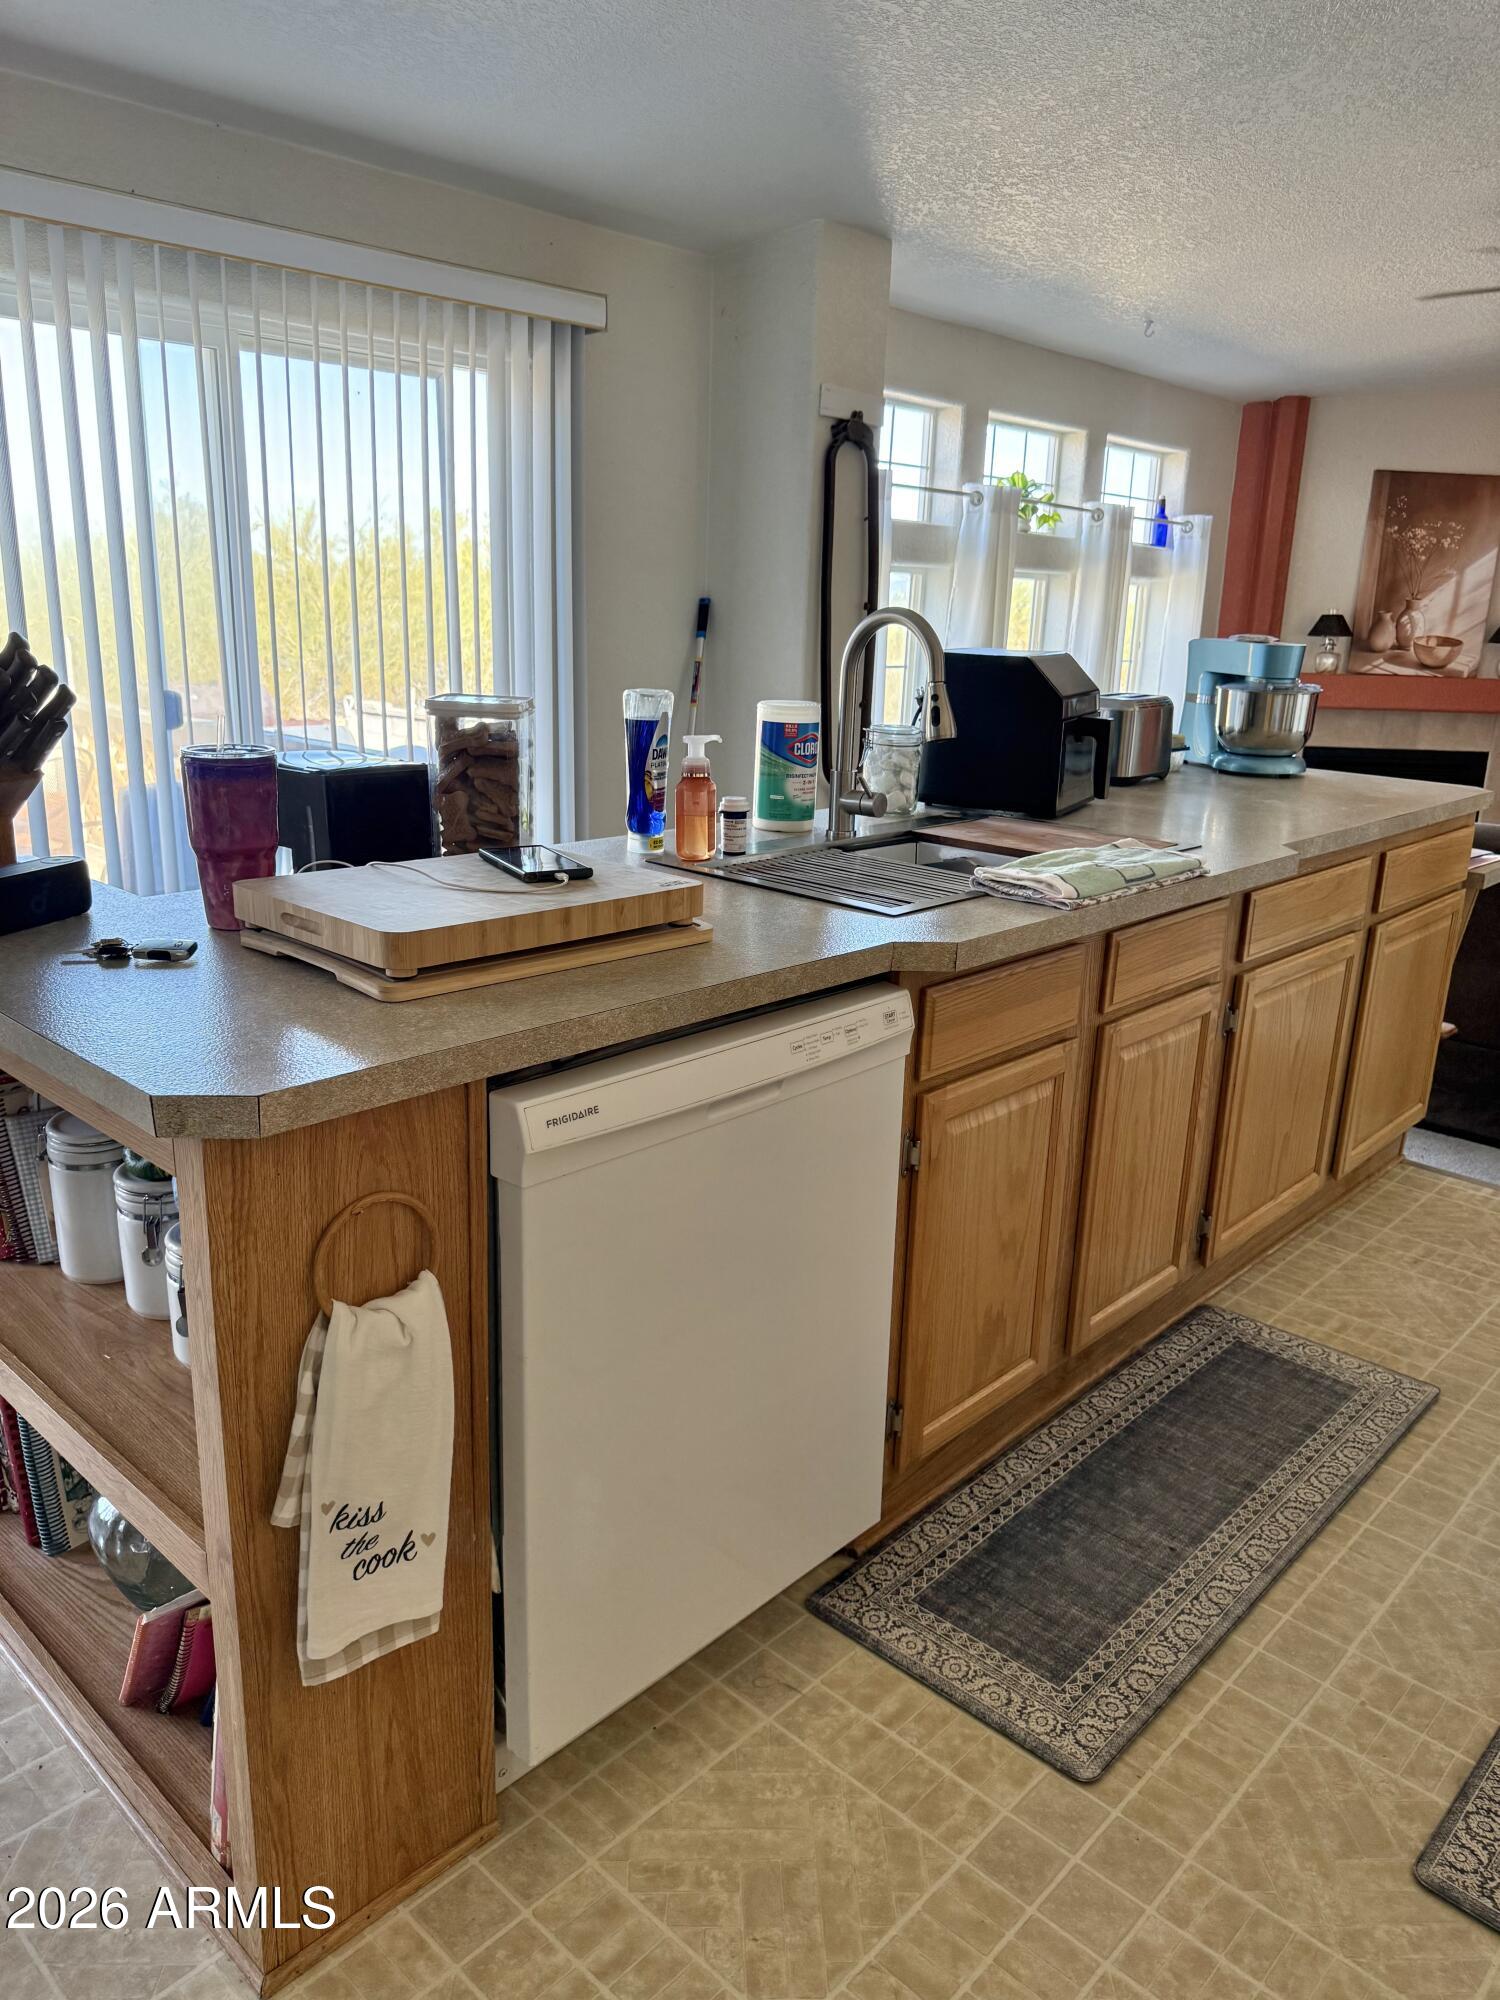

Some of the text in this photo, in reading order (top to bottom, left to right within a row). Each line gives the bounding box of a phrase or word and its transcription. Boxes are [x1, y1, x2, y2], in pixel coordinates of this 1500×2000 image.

[546, 1105, 600, 1129] FRIGIDAIRE
[329, 1500, 387, 1534] kiss
[340, 1531, 380, 1560] the
[352, 1529, 418, 1581] cook
